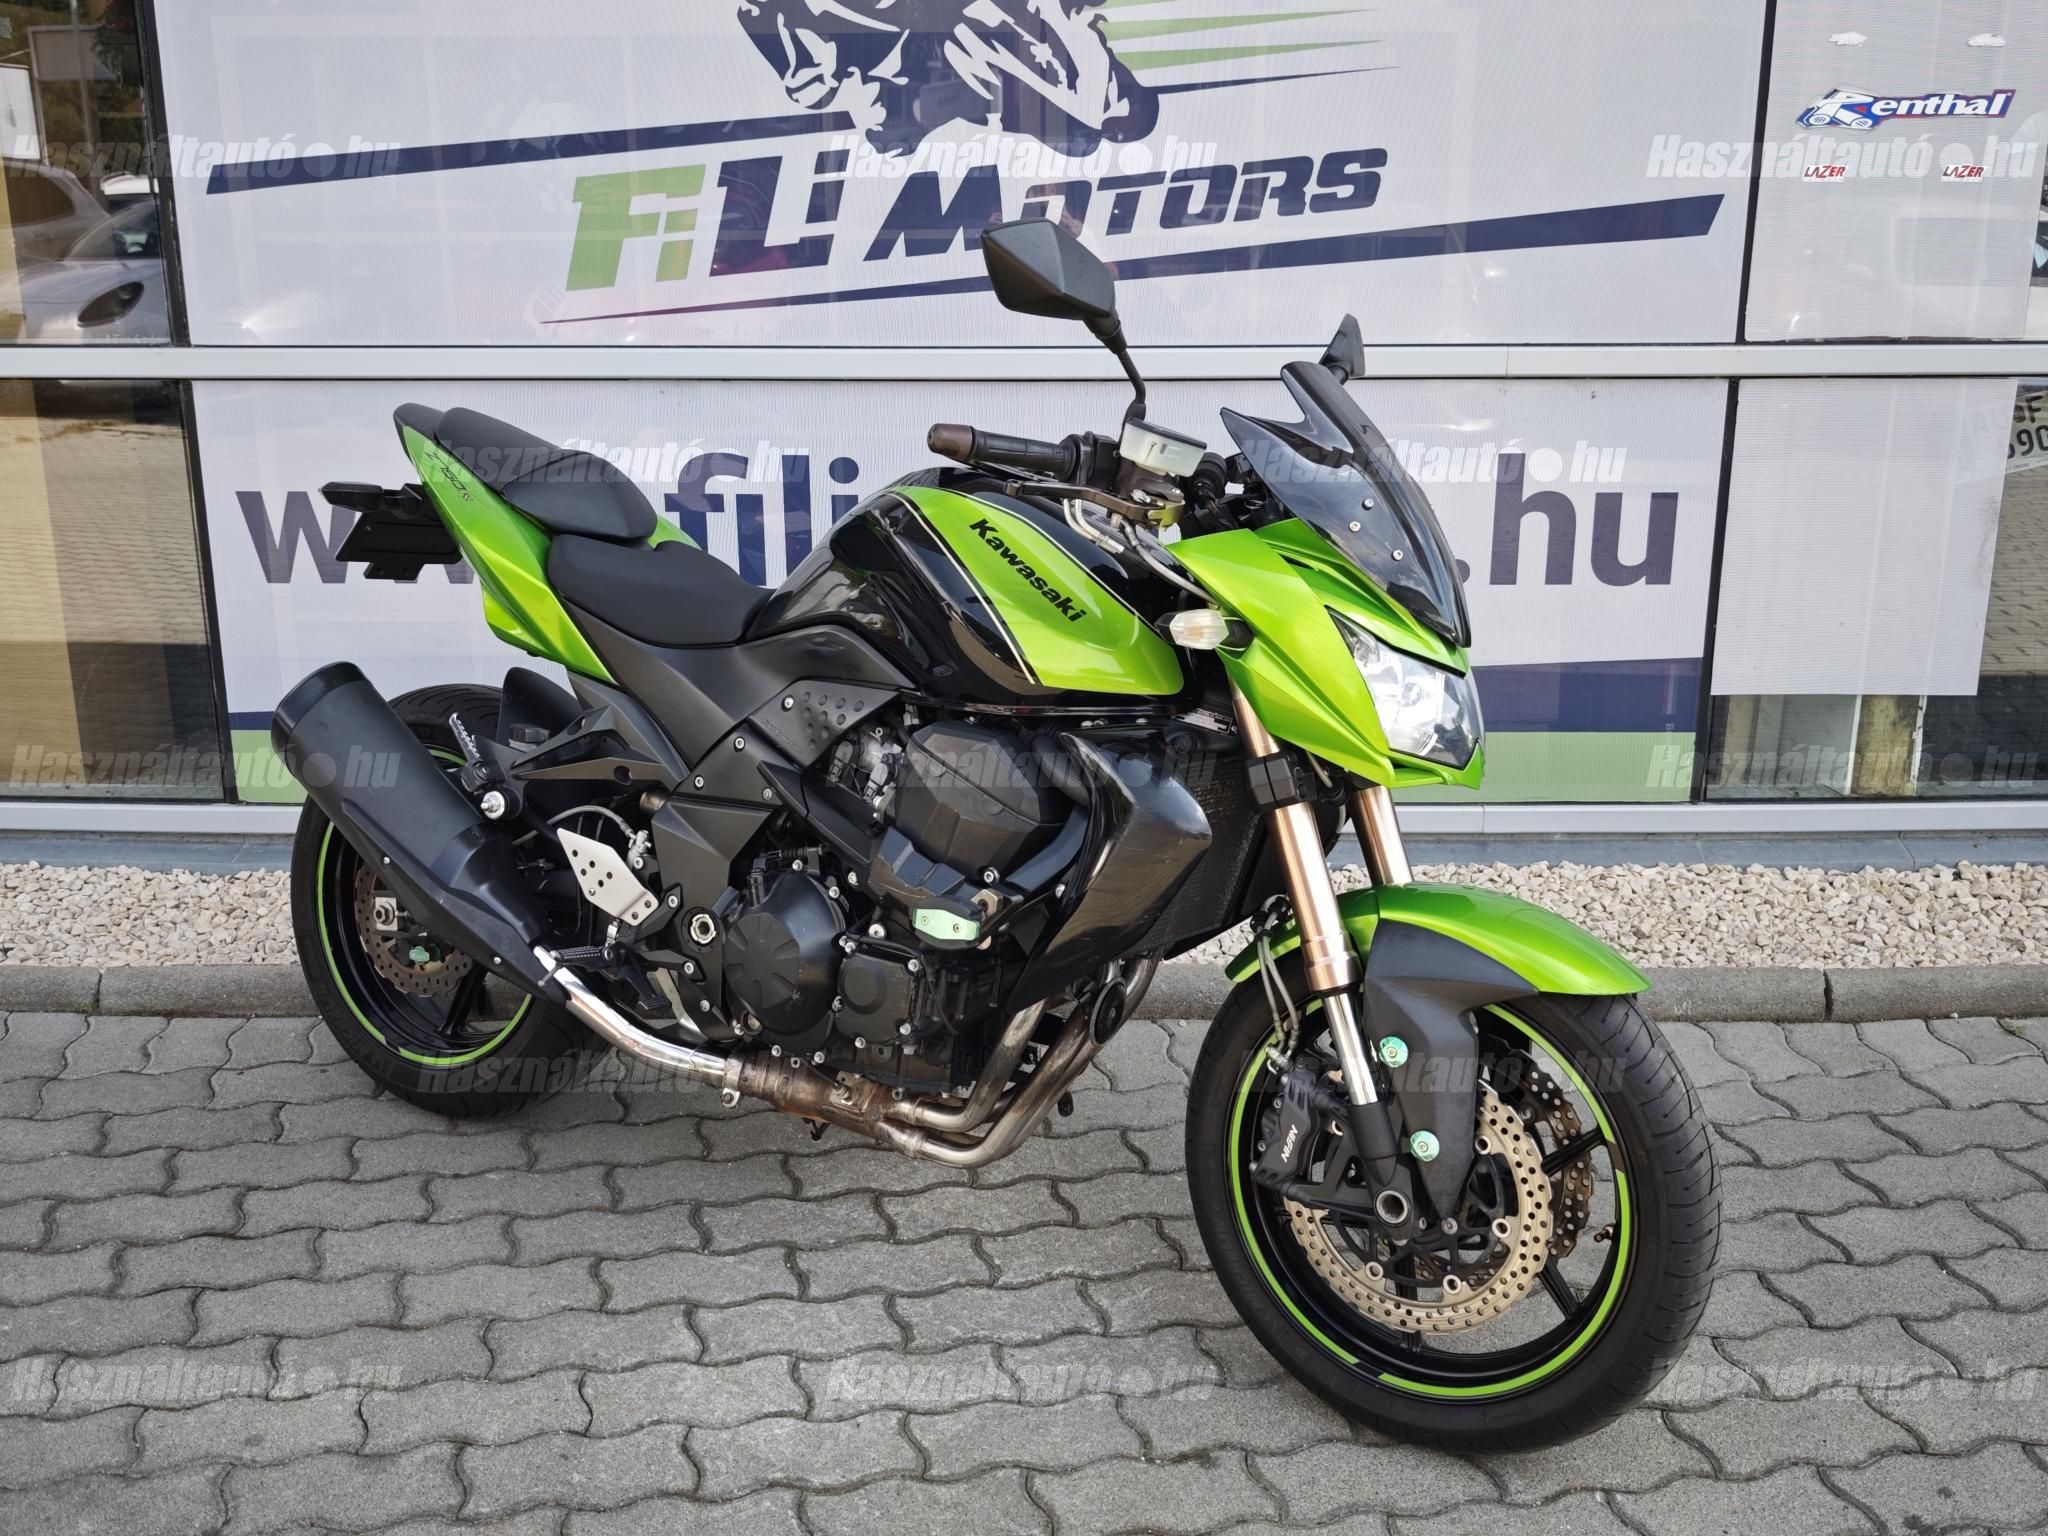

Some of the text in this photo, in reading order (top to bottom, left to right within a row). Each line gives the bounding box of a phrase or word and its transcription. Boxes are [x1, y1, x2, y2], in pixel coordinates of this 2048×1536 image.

[1798, 90, 2009, 129] Renthal
[1804, 164, 1847, 178] LAZER
[1942, 164, 1985, 178] LAZER
[969, 518, 1087, 622] Kawasaki
